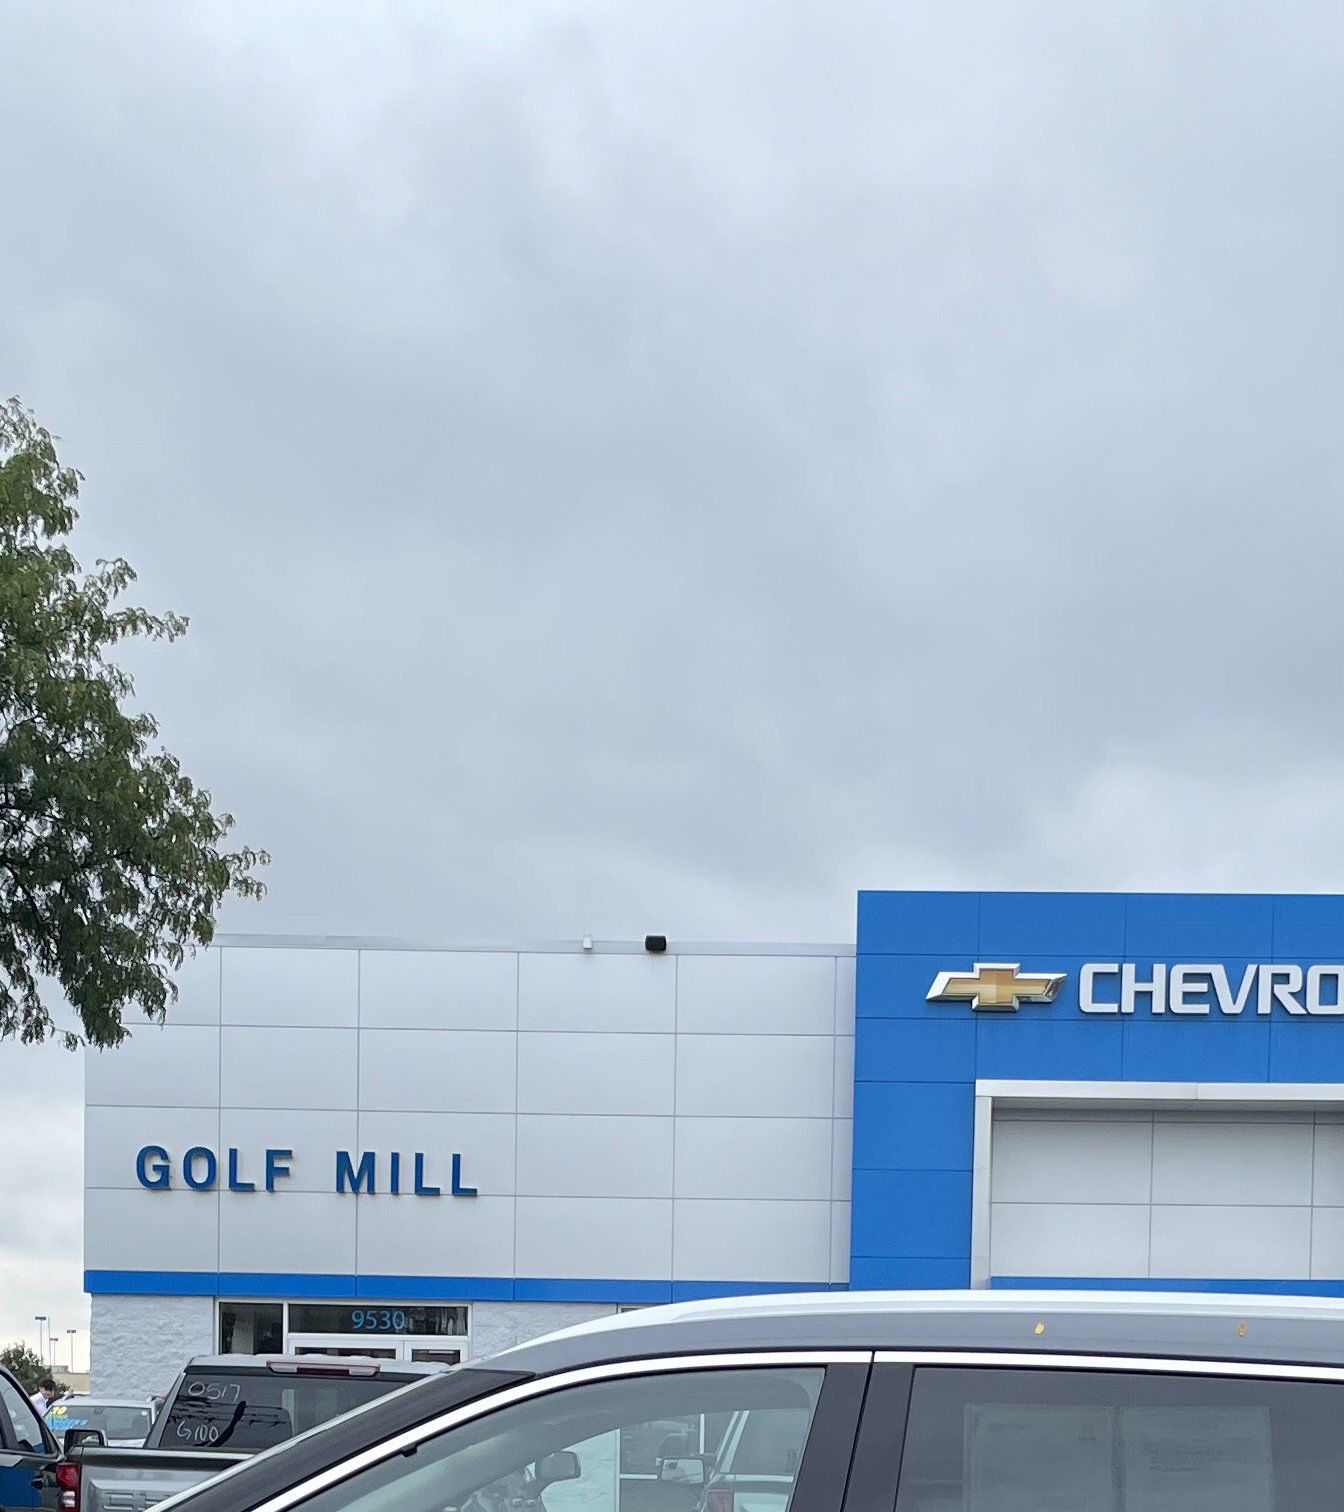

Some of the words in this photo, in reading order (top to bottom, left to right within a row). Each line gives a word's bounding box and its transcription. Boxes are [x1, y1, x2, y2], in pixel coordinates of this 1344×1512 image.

[135, 1144, 294, 1193] GOLF
[335, 1150, 479, 1197] MILL
[351, 1309, 405, 1330] 9530
